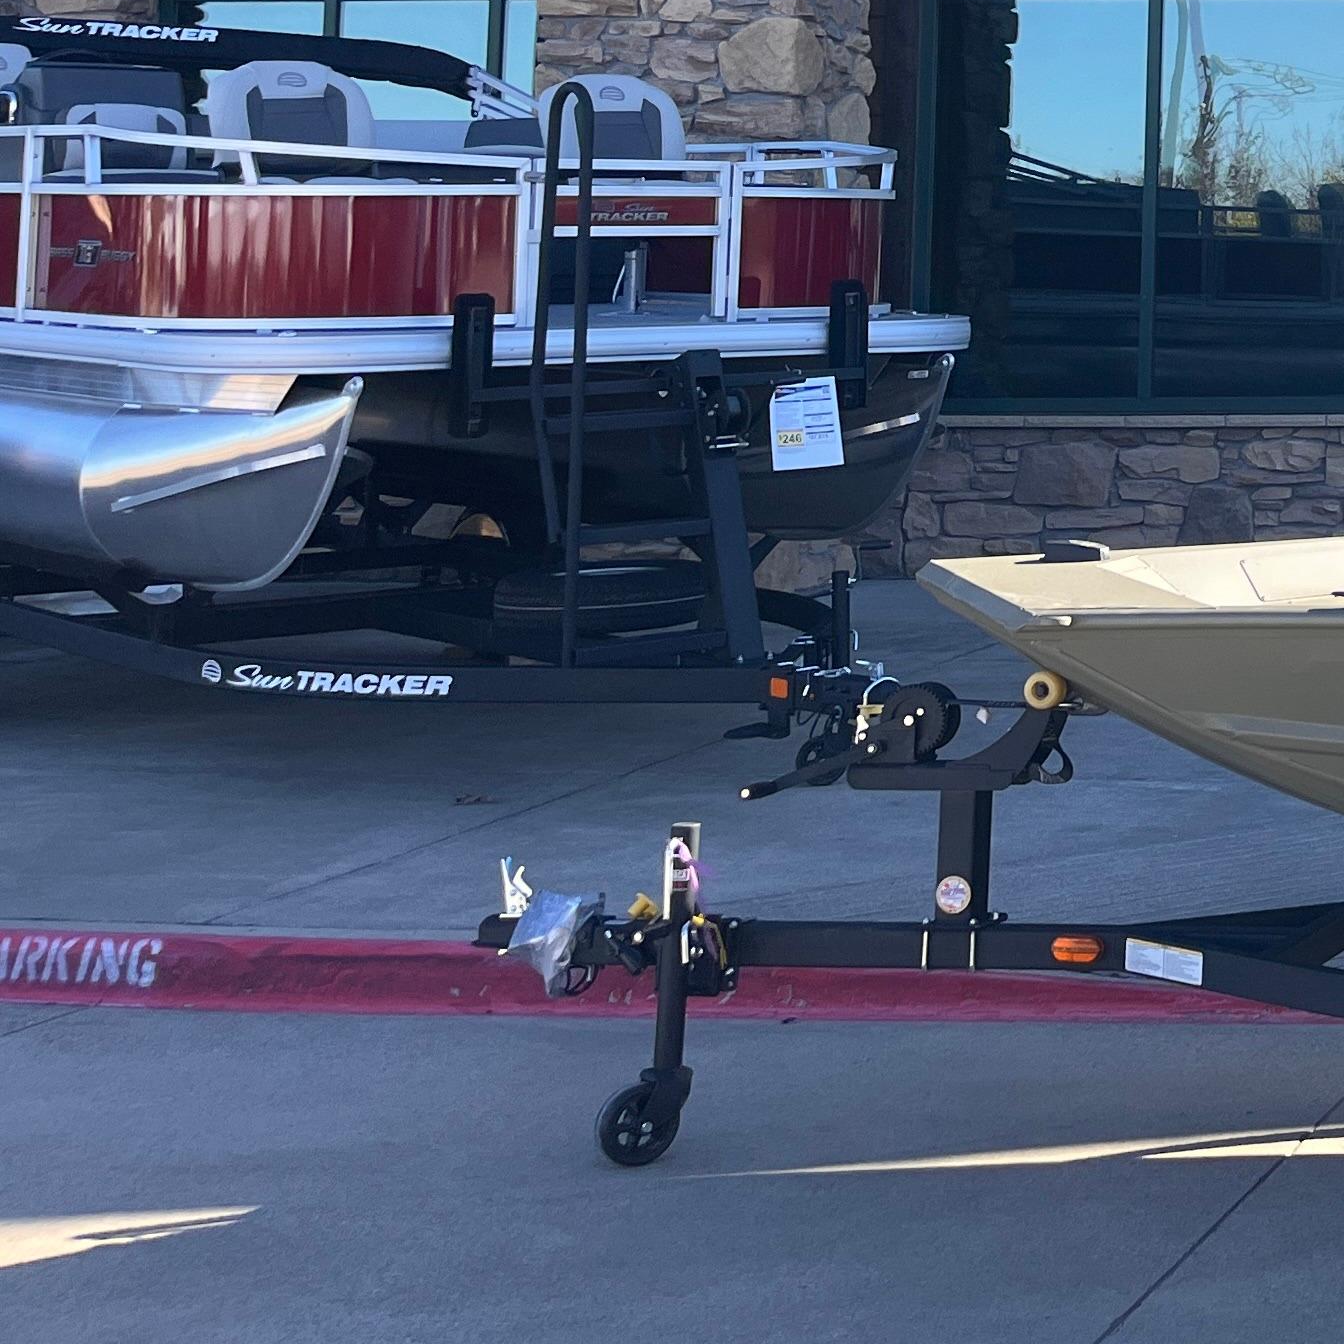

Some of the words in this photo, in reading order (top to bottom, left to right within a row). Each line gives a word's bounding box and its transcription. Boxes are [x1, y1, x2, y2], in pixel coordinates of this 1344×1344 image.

[13, 17, 84, 35] Sun
[85, 22, 219, 42] TRACKER
[226, 664, 295, 690] Sun
[296, 670, 453, 696] TRACKER
